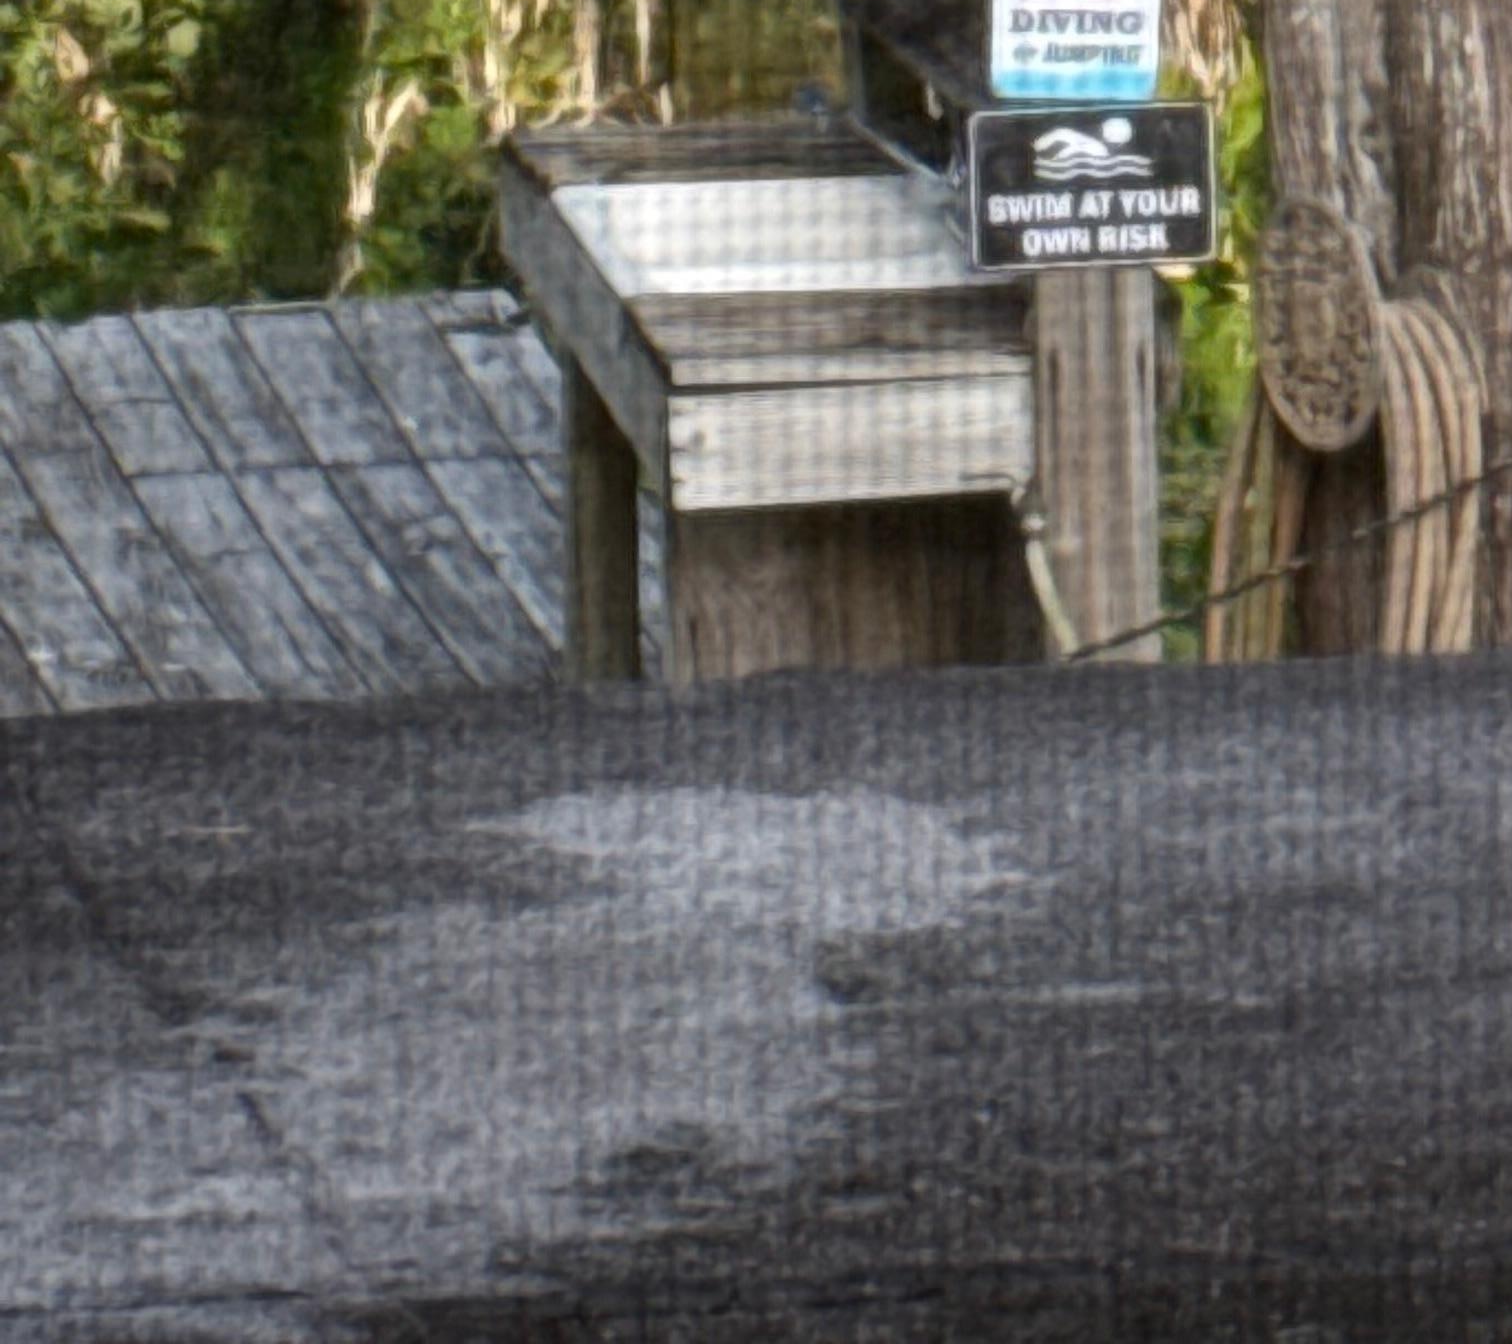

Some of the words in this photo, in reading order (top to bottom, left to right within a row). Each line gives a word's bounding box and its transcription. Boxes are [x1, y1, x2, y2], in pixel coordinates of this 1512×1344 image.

[1008, 9, 1145, 35] DIVING
[988, 191, 1073, 225] SWIM
[1079, 189, 1115, 220] AT
[1119, 184, 1200, 217] YOUR
[1021, 226, 1091, 257] OWN
[1097, 222, 1170, 253] RISK
